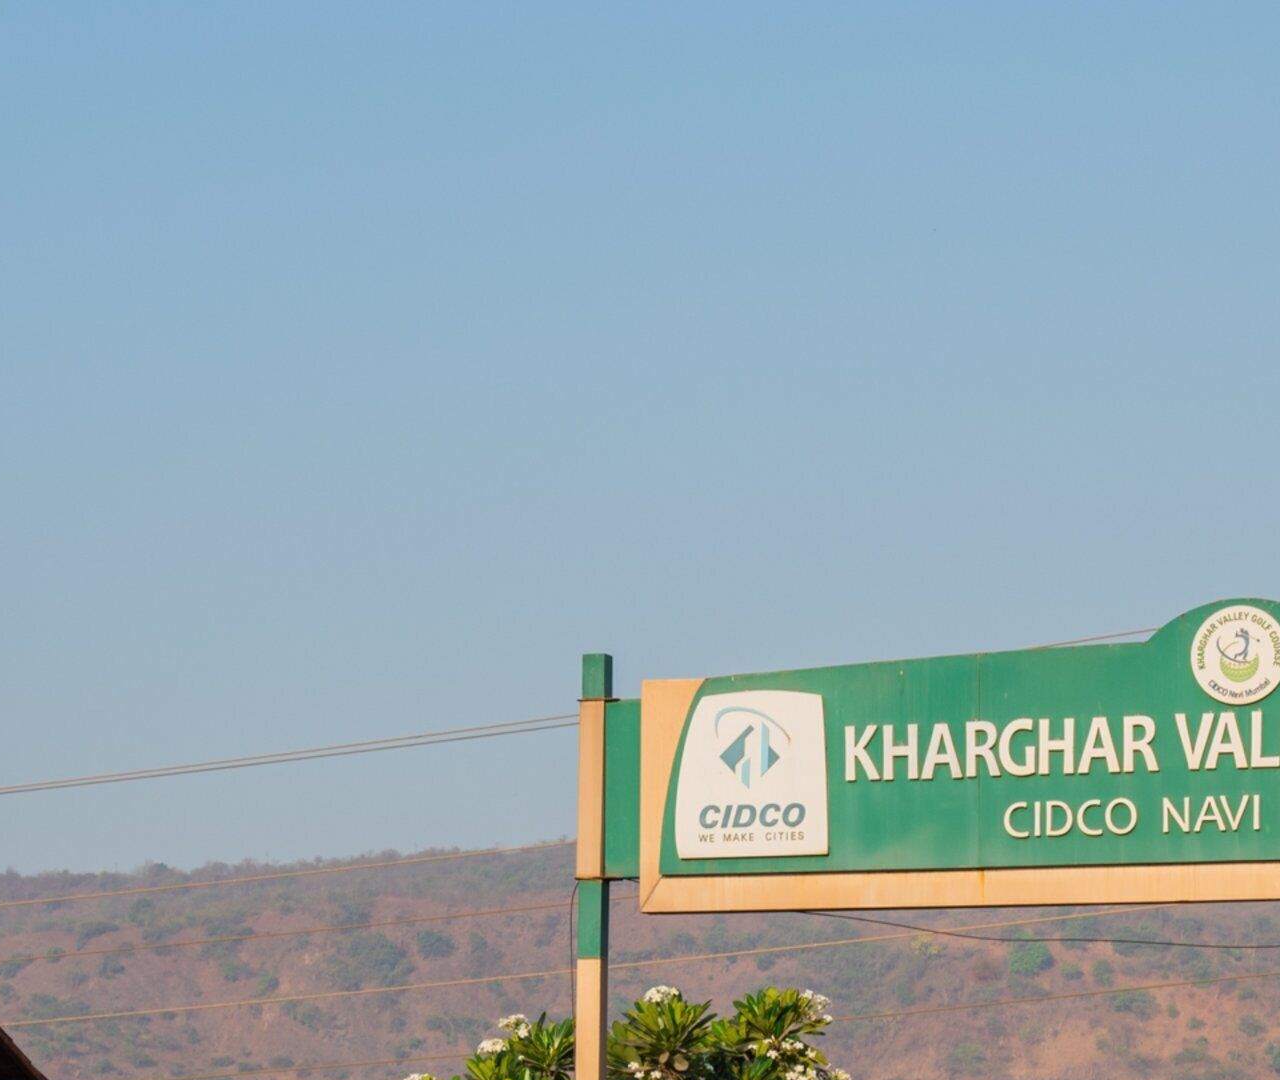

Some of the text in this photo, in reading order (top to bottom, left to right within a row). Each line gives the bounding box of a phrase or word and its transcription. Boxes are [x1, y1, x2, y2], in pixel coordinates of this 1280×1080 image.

[1216, 612, 1249, 625] VALLEY
[1251, 614, 1272, 631] GOLF
[844, 714, 1160, 782] KHARGHAR
[698, 803, 806, 829] CIDCO
[1003, 796, 1138, 839] CIDCO
[1162, 793, 1261, 834] NAVI
[698, 831, 805, 843] WE MAKE CITIES
